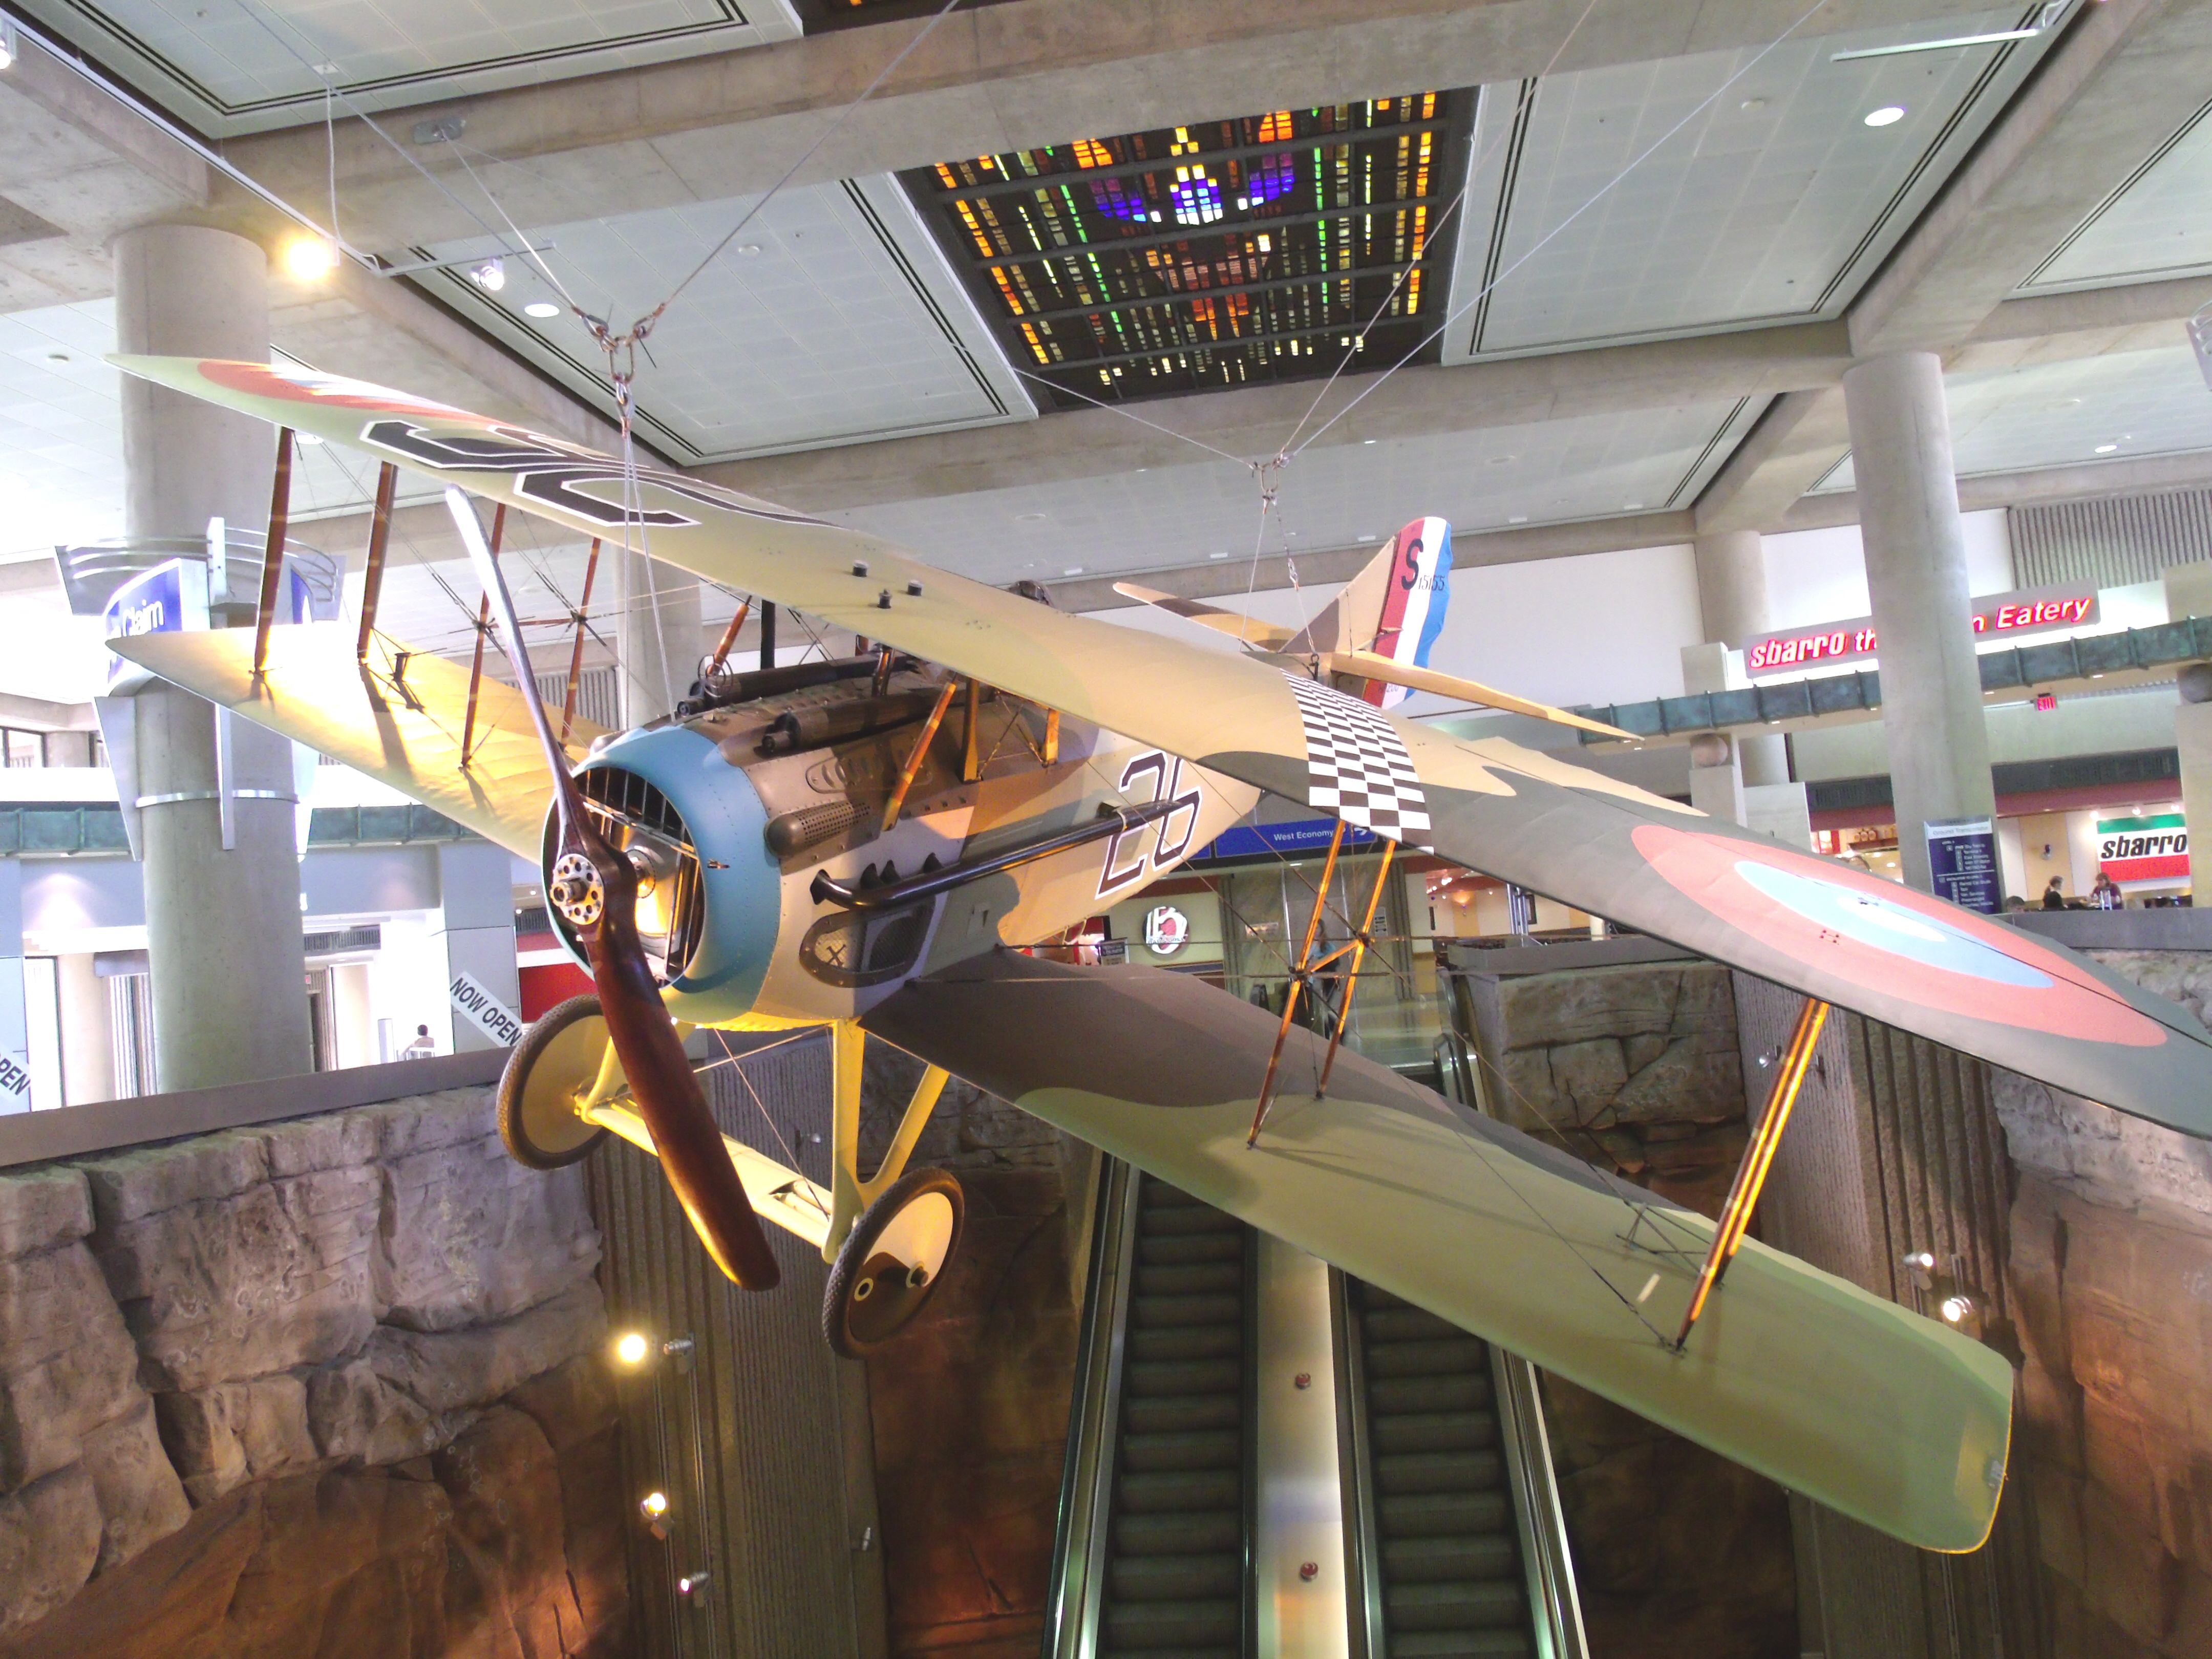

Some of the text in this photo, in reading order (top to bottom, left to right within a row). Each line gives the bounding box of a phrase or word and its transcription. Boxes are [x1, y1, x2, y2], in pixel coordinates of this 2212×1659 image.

[1750, 632, 1846, 668] sbarro
[1855, 629, 1877, 651] th
[1997, 599, 2091, 629] Eatery
[1095, 749, 1202, 900] 26
[1273, 833, 1294, 841] West
[1296, 830, 1333, 839] Economy
[2101, 834, 2187, 859] sbarro
[450, 977, 522, 1047] NOW OPEN
